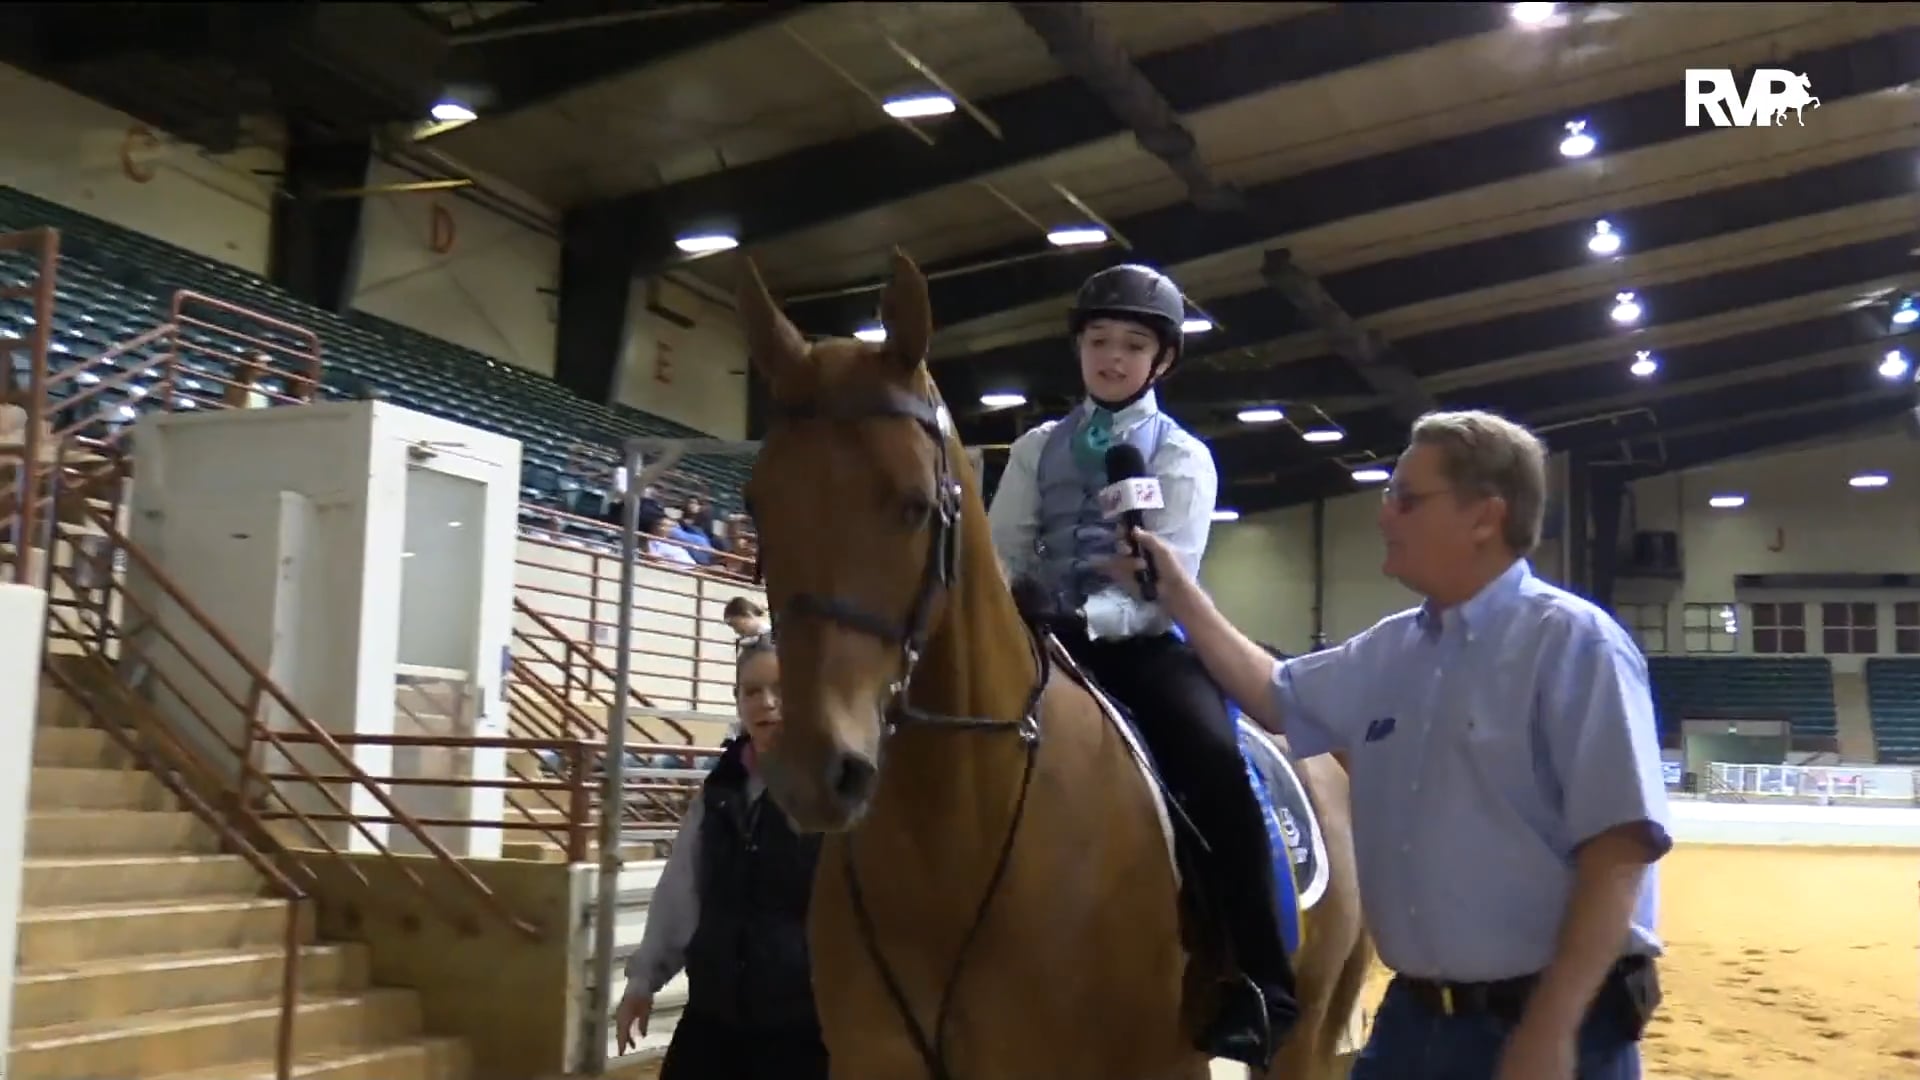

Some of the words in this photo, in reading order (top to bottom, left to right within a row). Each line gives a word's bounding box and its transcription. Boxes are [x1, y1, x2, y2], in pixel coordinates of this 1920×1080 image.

[120, 125, 159, 184] C
[431, 204, 456, 254] D
[654, 341, 674, 384] E
[1767, 528, 1784, 552] J
